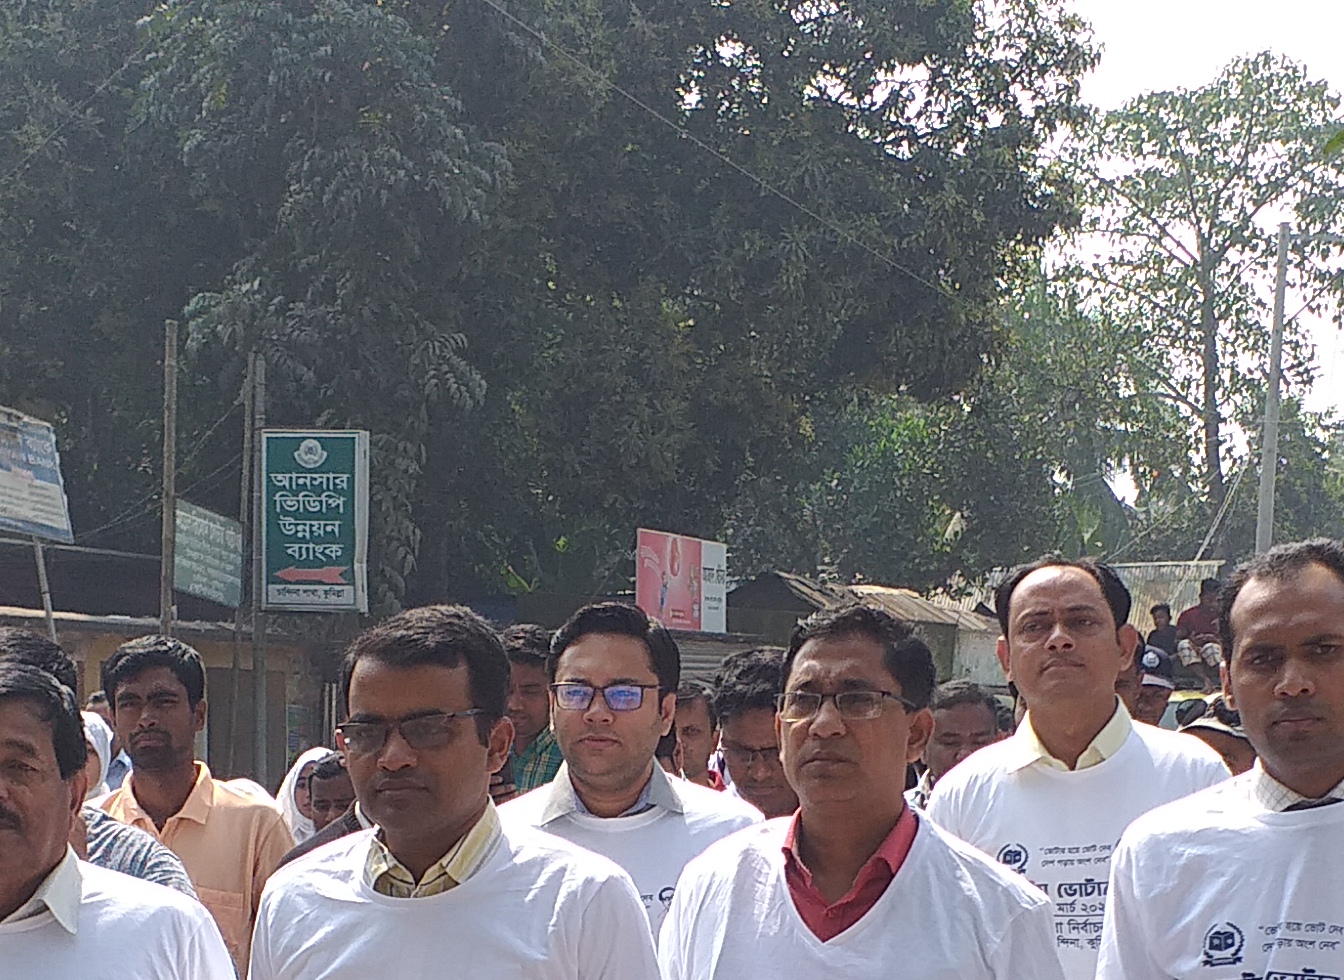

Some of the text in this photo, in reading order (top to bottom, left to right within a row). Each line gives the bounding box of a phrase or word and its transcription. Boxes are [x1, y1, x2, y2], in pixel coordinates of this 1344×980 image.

[269, 471, 351, 491] আনসার
[273, 491, 346, 514] ভিডিপি
[278, 514, 343, 540] উন্নয়ন
[284, 543, 345, 562] ব্যাংক
[1056, 898, 1105, 914] মার্চ ২০২
[1304, 921, 1325, 933] ভোট
[1328, 924, 1344, 936] দেব
[1295, 938, 1315, 949] অংশ
